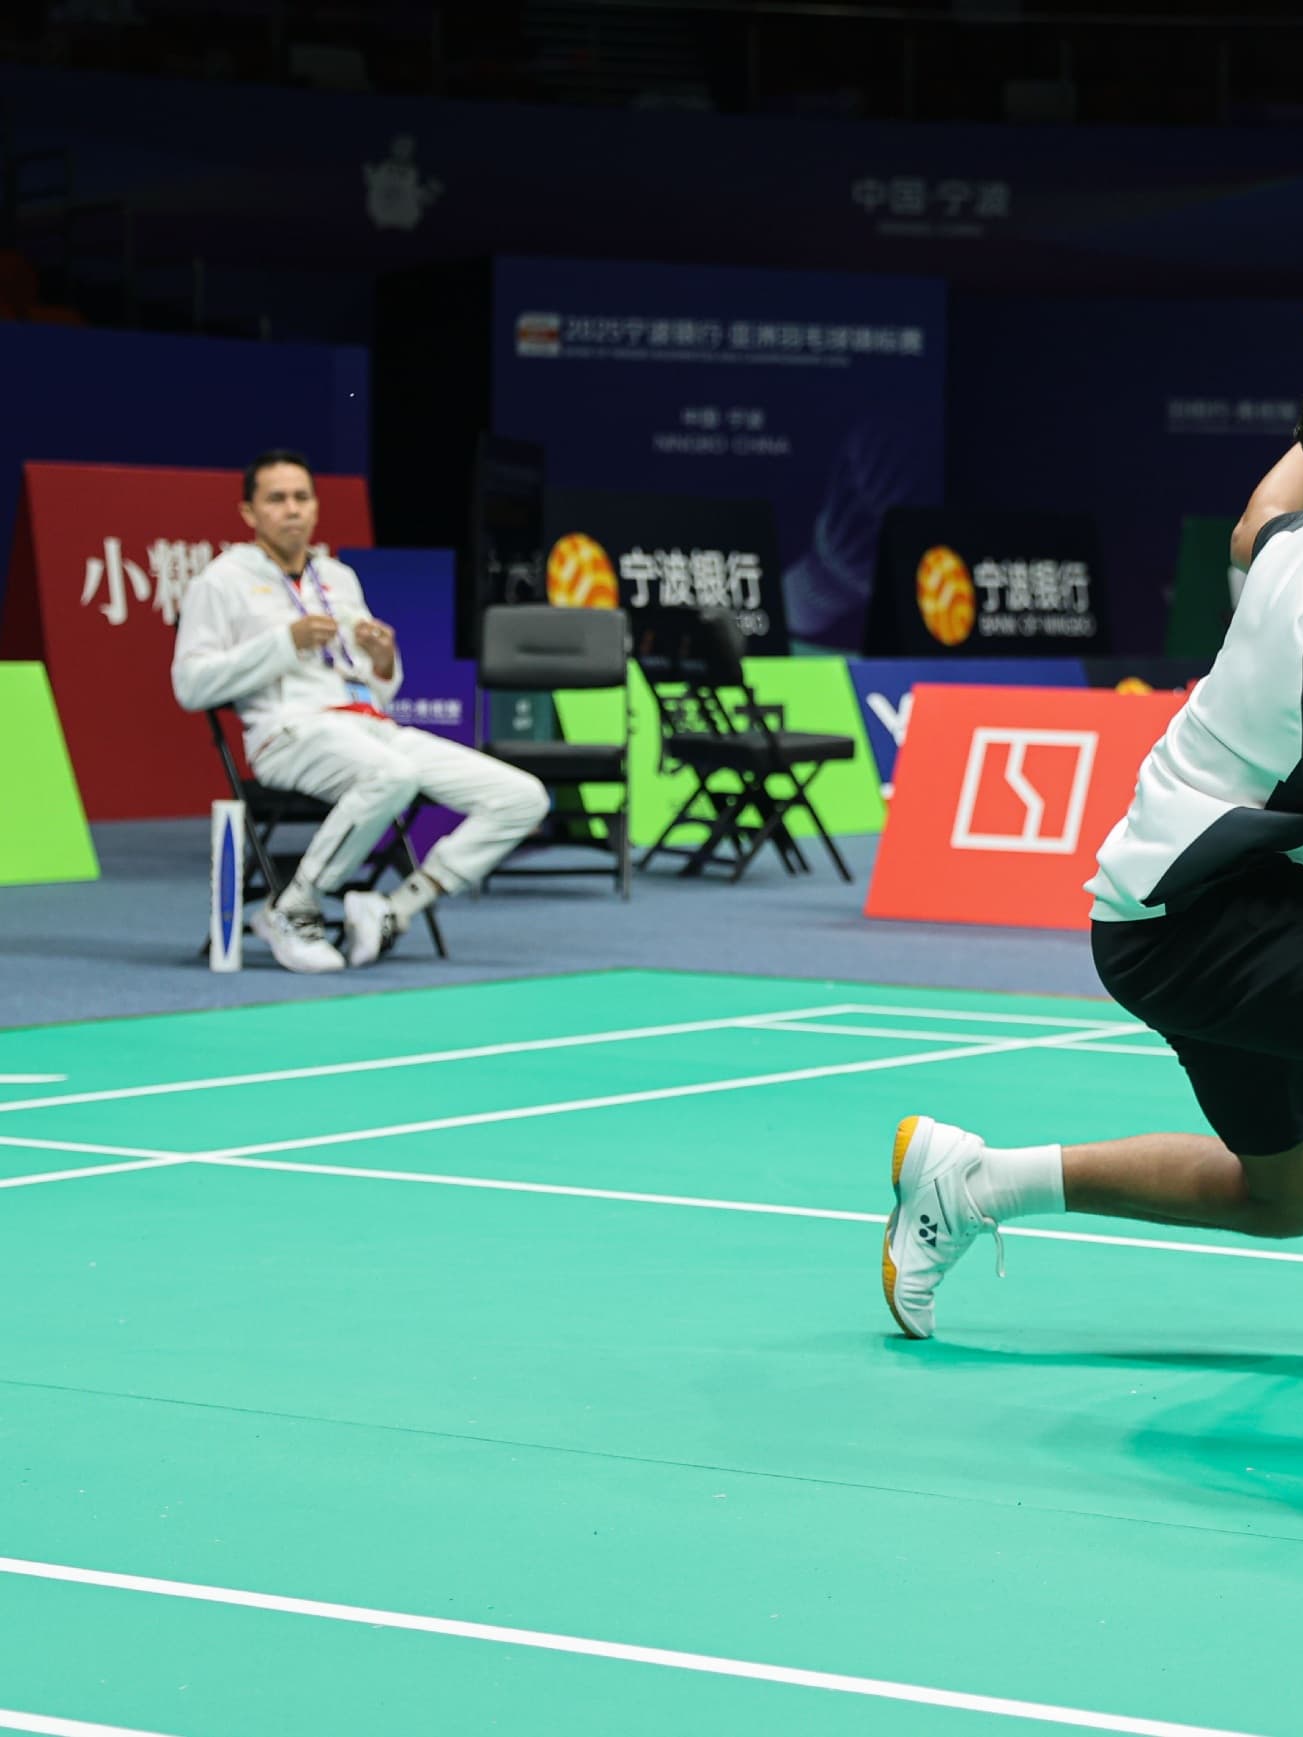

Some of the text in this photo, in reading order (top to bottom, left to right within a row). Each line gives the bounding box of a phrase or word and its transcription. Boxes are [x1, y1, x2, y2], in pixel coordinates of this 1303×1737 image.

[619, 546, 762, 609] 宁波银行
[973, 557, 1090, 614] 宁波银行
